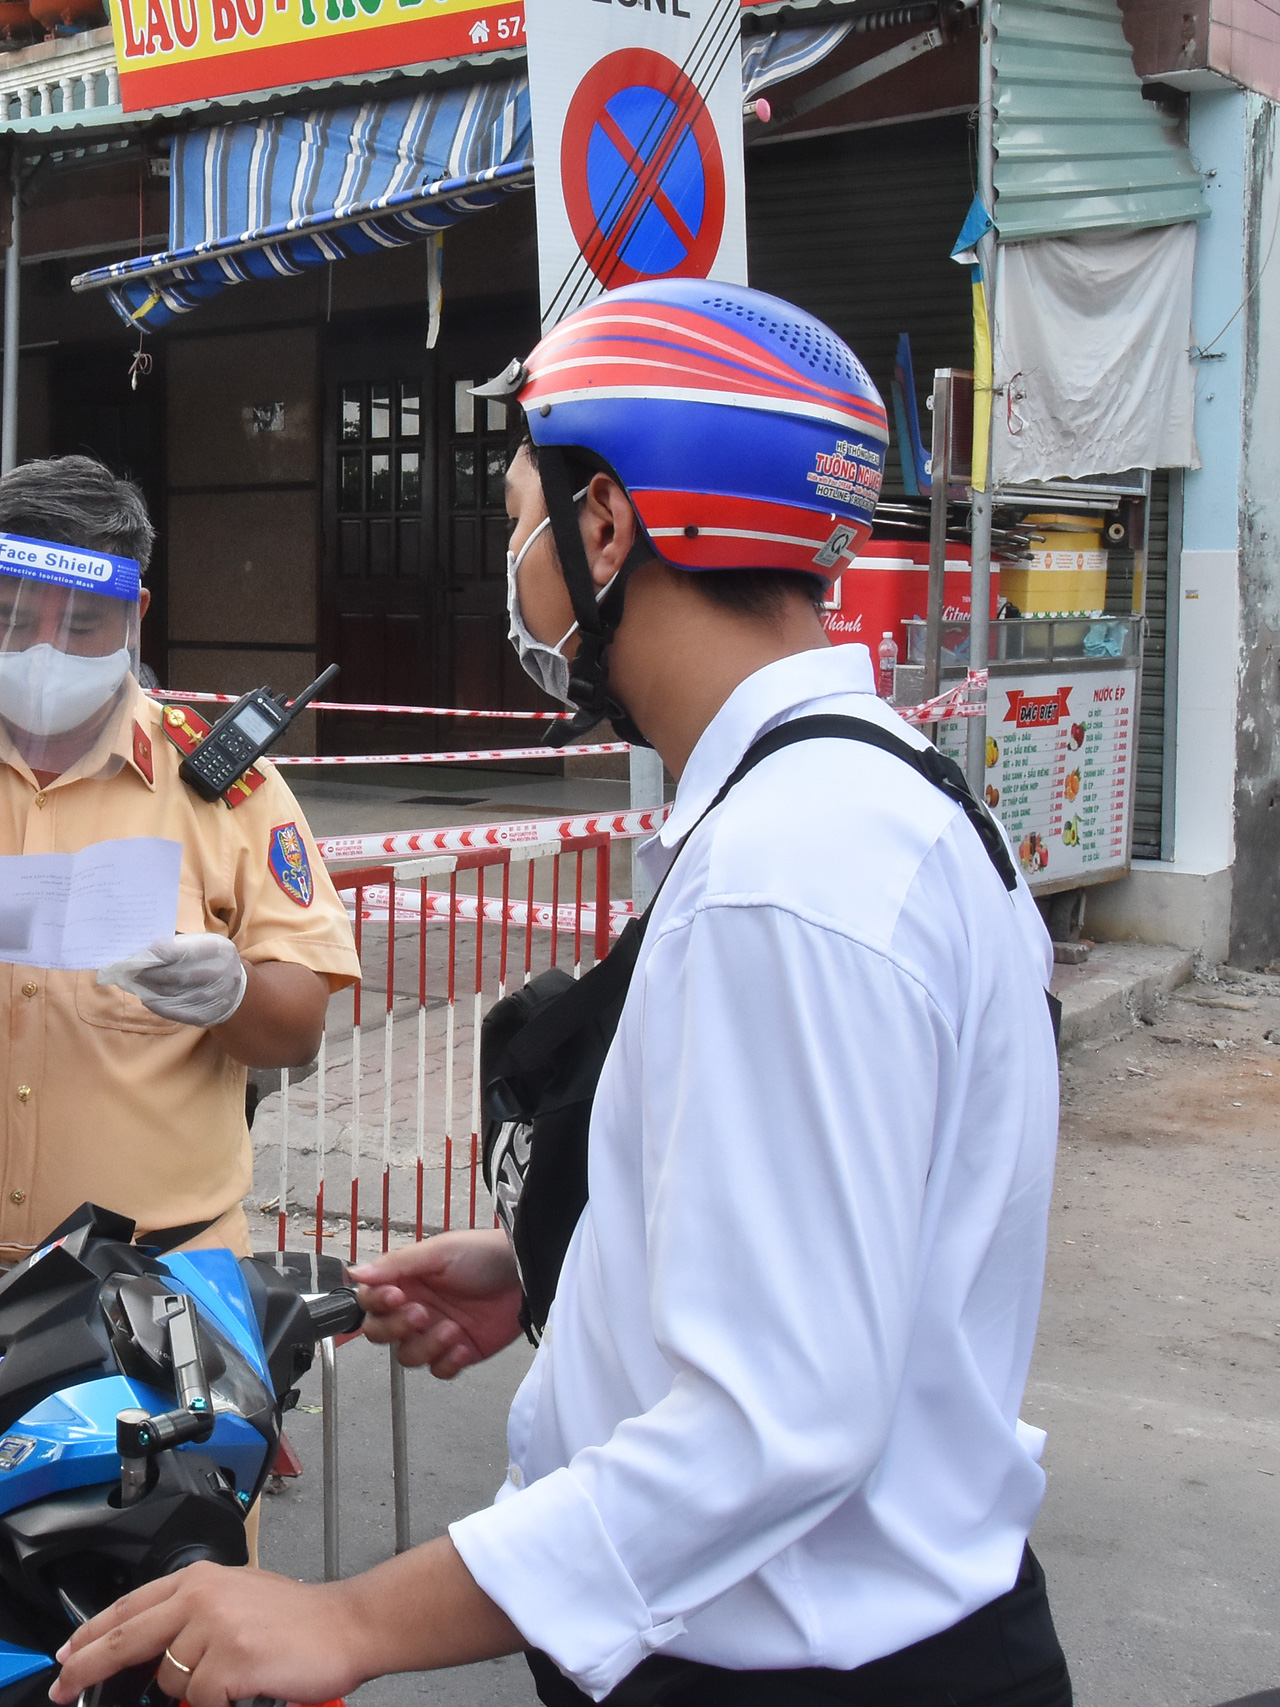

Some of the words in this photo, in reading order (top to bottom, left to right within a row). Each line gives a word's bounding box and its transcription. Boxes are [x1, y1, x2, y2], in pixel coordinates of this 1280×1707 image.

[497, 16, 527, 40] 57
[44, 552, 105, 578] Shield
[39, 571, 74, 585] Isolation
[76, 579, 95, 590] Mask
[1020, 703, 1038, 724] ĐẶC
[1039, 701, 1058, 723] BIỆT
